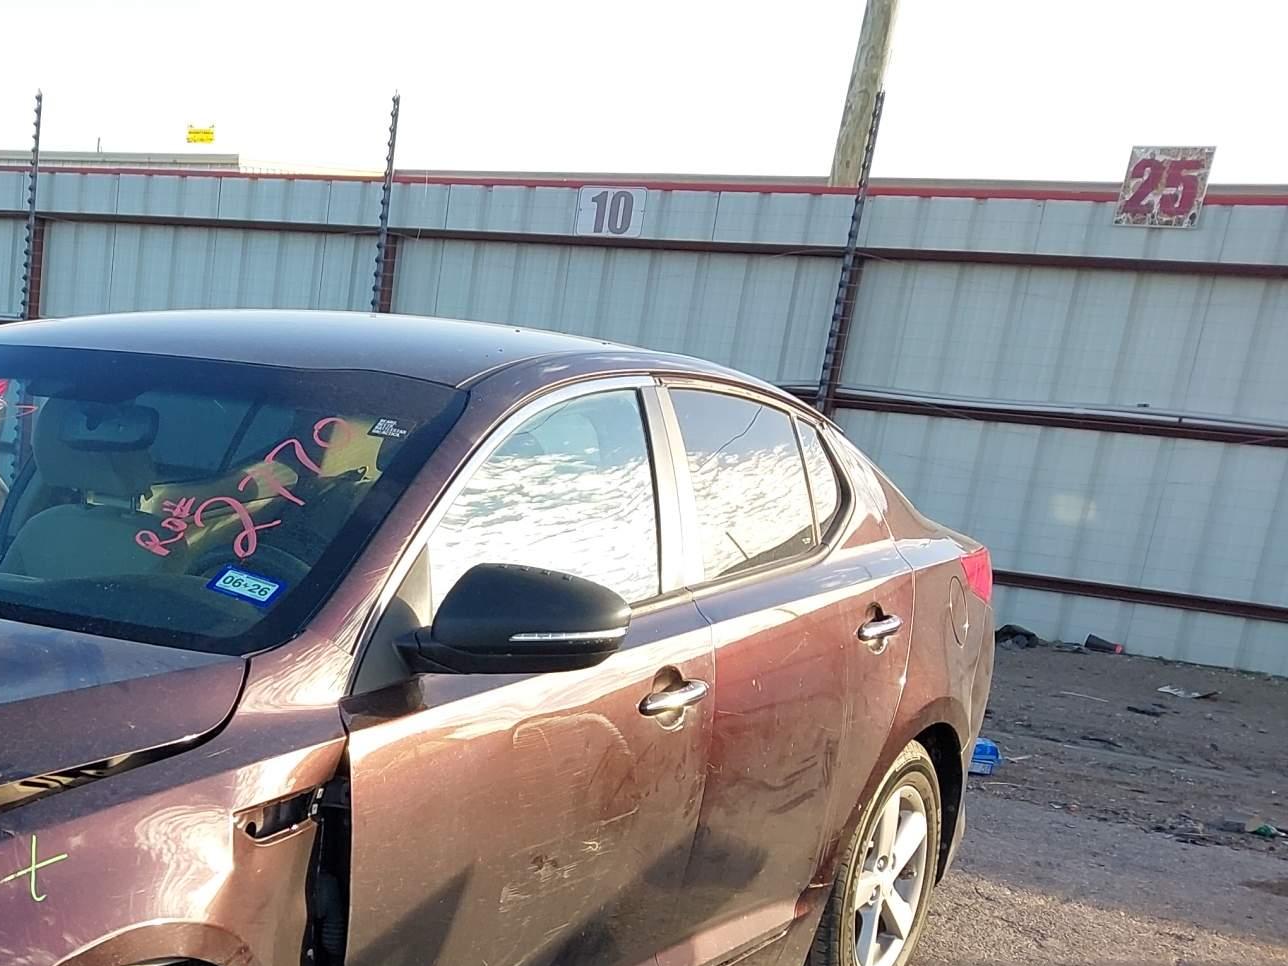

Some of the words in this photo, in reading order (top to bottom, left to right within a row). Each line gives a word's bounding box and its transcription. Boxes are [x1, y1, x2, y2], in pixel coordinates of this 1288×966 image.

[591, 190, 634, 235] 10
[1121, 158, 1206, 217] 25
[193, 416, 353, 558] 2770
